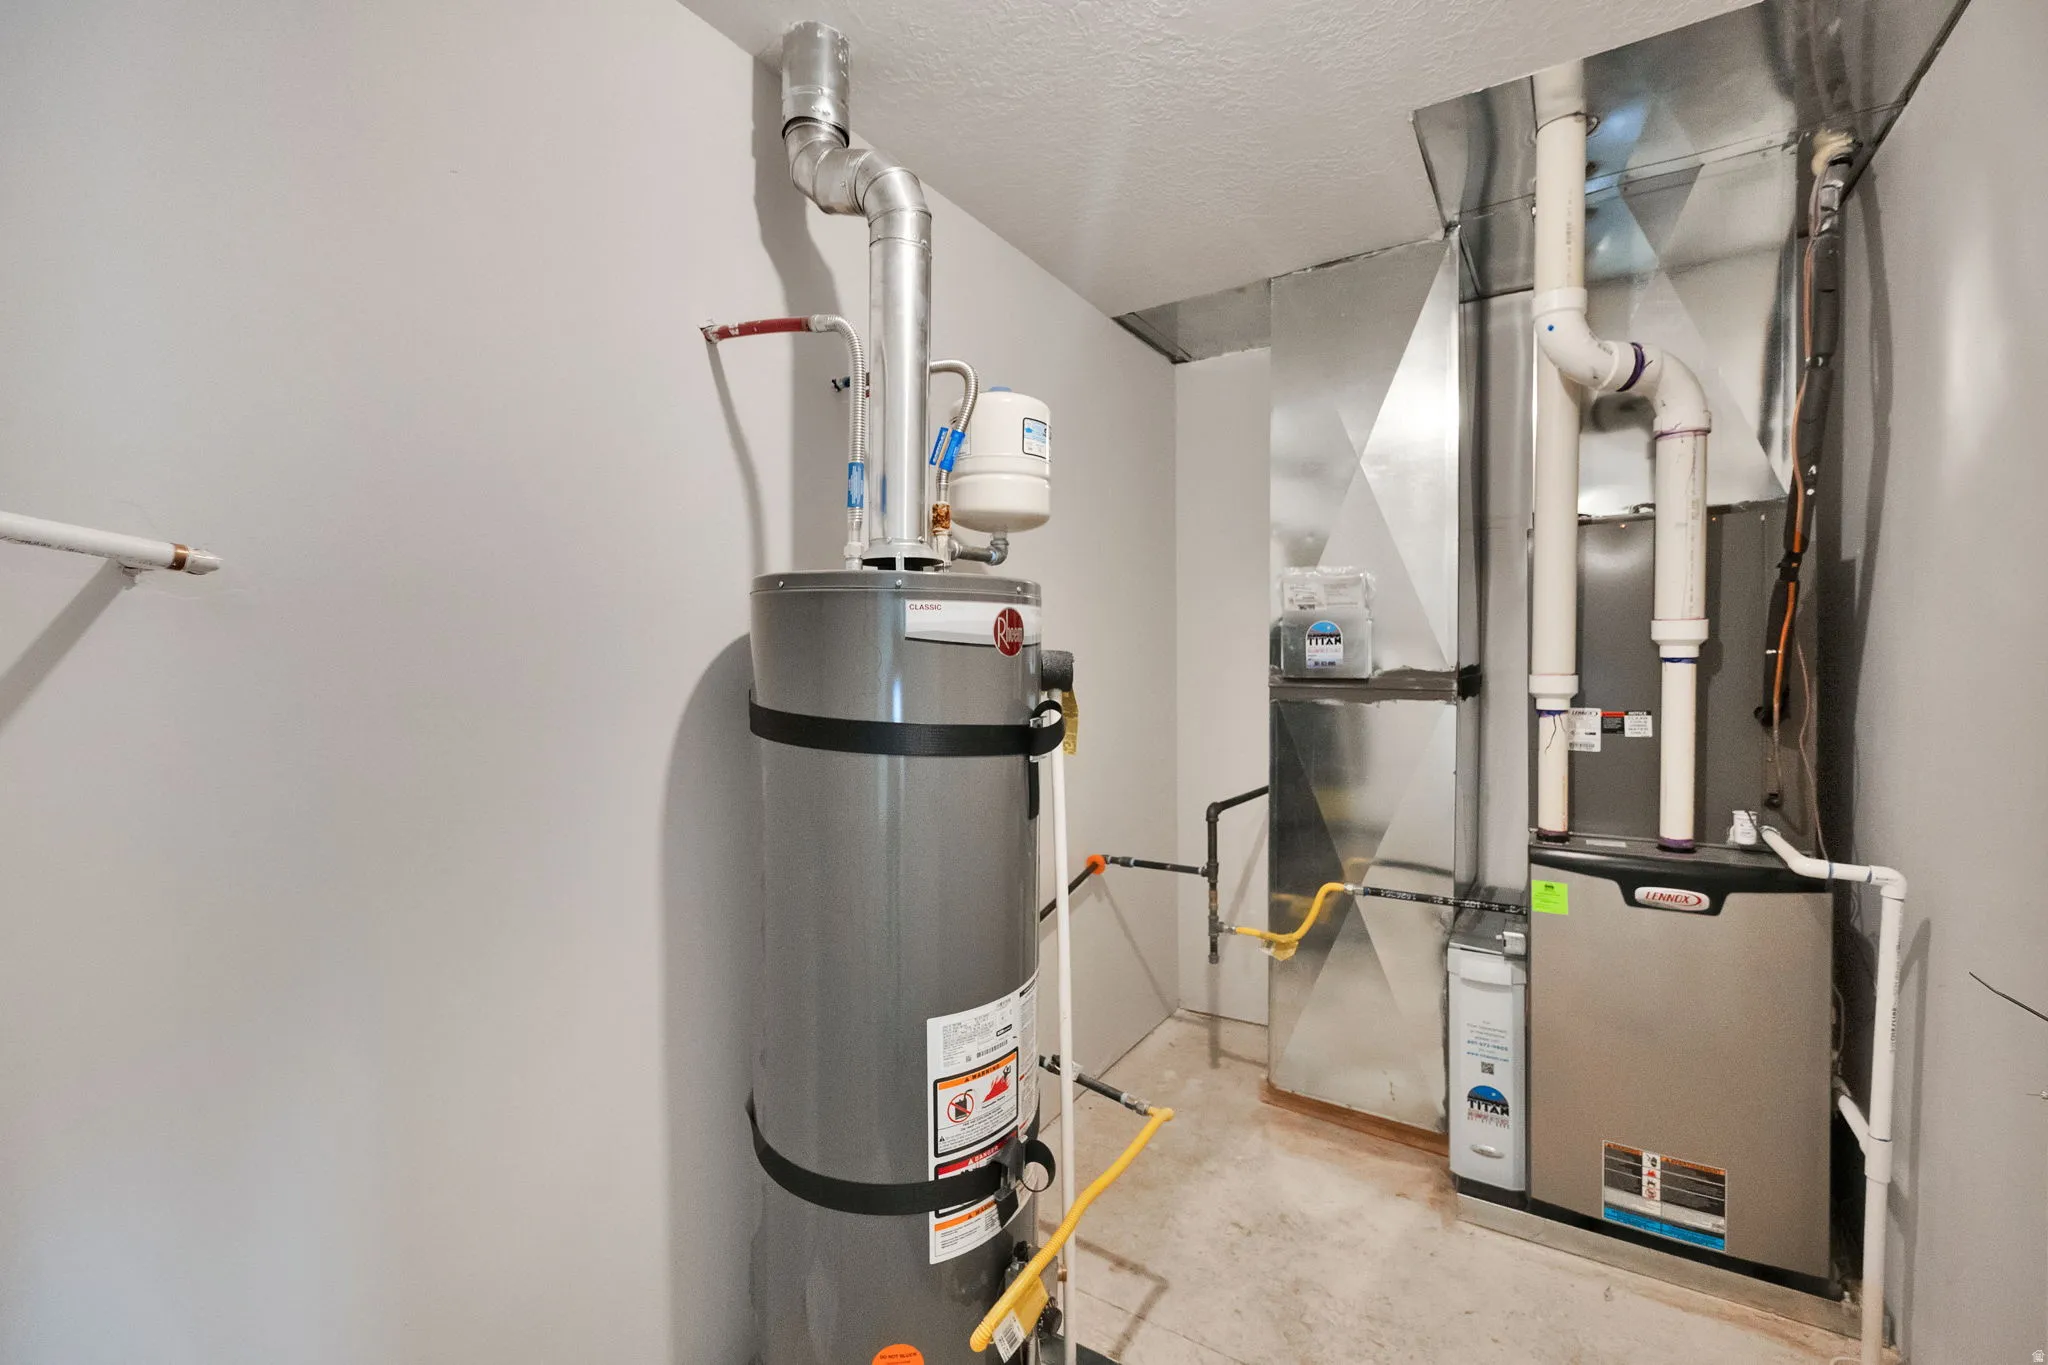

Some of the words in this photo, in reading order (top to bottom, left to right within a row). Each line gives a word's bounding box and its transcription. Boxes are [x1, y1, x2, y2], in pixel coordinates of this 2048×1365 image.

[909, 603, 943, 611] CLASSIC
[996, 609, 1023, 649] Rheem
[1307, 637, 1342, 646] TITAN
[1645, 891, 1691, 905] LENNOX
[971, 1063, 1001, 1080] WARNING
[1467, 1099, 1510, 1117] TITAN
[973, 1145, 999, 1163] DANGER
